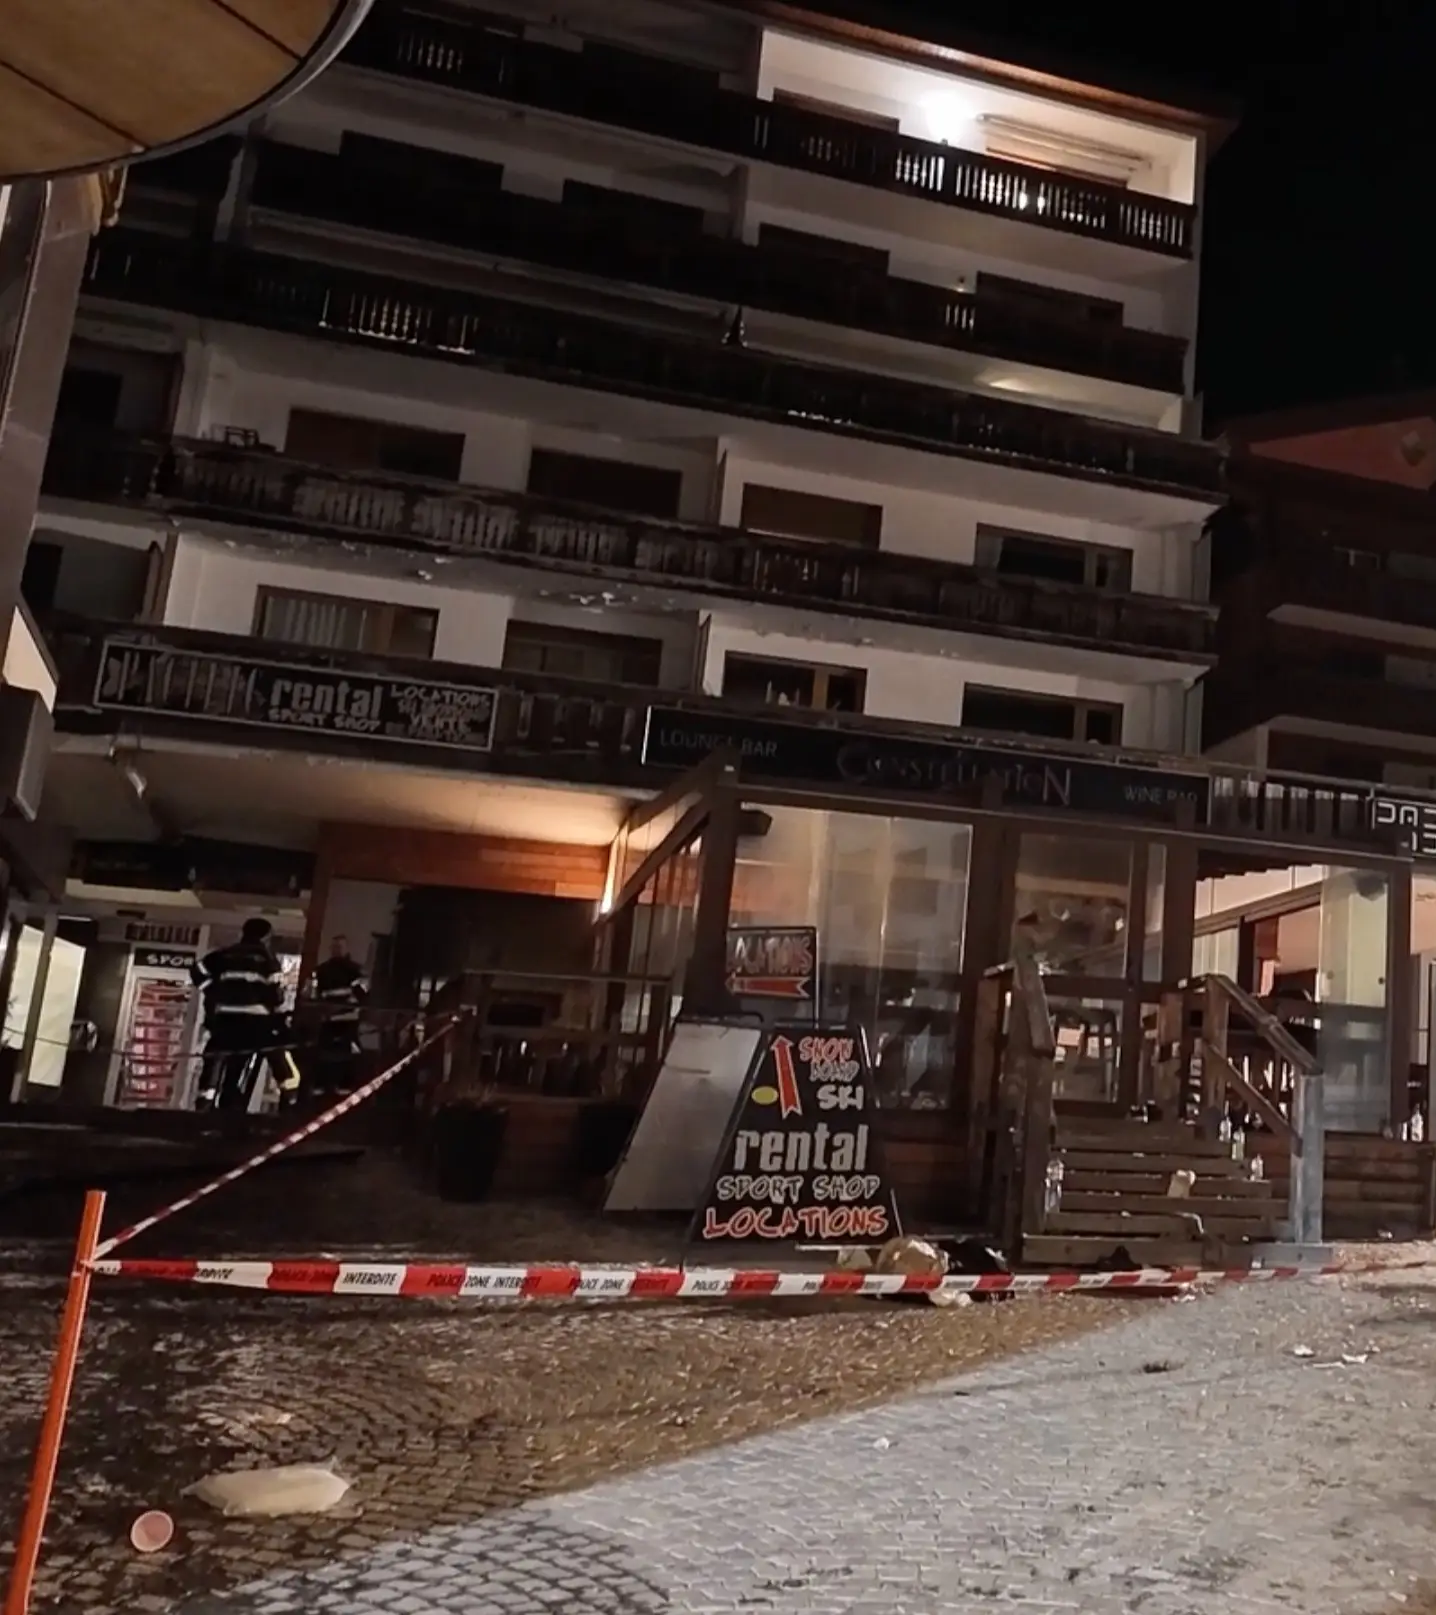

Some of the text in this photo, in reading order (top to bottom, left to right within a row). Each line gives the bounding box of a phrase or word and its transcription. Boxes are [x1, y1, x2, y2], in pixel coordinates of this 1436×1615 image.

[270, 678, 383, 719] rental
[391, 684, 490, 707] LOCATIONS
[268, 707, 327, 727] SPORT
[333, 714, 381, 733] SHOP
[741, 737, 777, 757] BAR
[1123, 784, 1161, 805] WINE
[798, 1036, 854, 1062] SNOW
[816, 1085, 864, 1110] SKI
[734, 1122, 869, 1172] rental
[716, 1175, 881, 1204] SPORT SHOP
[702, 1206, 888, 1239] LOCATIONS
[343, 1271, 398, 1287] INTERDITE
[465, 1275, 491, 1289] ZONE
